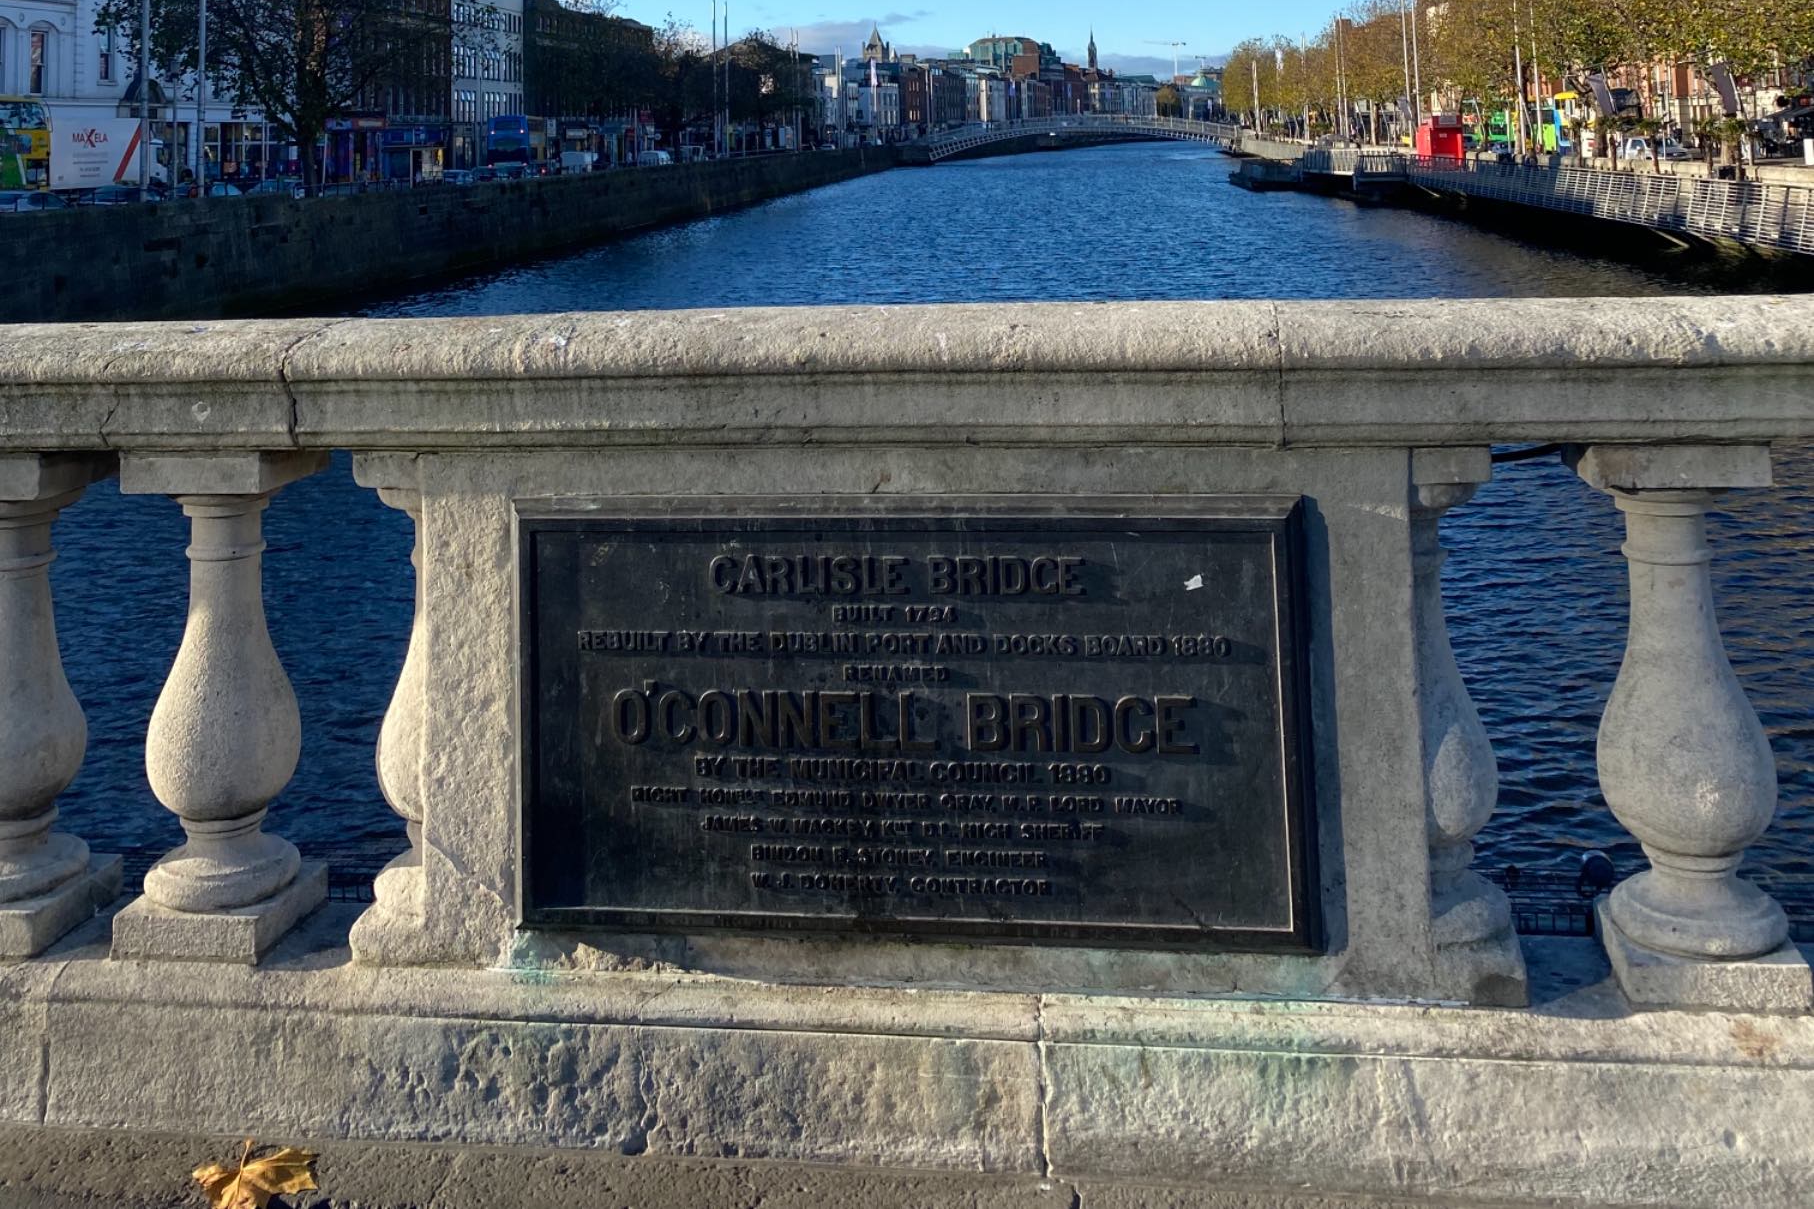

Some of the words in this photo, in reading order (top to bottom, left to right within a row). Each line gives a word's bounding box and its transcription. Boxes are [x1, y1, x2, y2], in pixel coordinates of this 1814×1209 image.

[72, 129, 108, 148] MAXELA
[709, 554, 911, 596] CARLISLE
[927, 555, 1087, 597] BRIDGE
[832, 605, 895, 623] BUILT
[904, 605, 958, 623] 1794
[577, 630, 669, 652] REBUILT
[676, 630, 706, 652] BY
[713, 631, 763, 653] THE
[769, 632, 859, 655] DUBLIN
[865, 633, 933, 655] PORT
[935, 633, 988, 655] AND
[993, 634, 1079, 656] DOCKS
[1084, 635, 1166, 657] BOARD
[1171, 634, 1232, 658] 1880
[843, 664, 949, 682] RENAMED
[612, 679, 939, 752] O'CONNELL
[966, 692, 1201, 756] BRIDGE
[695, 755, 727, 777] BY
[731, 756, 781, 779] THE
[790, 757, 923, 782] MUNICIPAL
[929, 760, 1041, 784] COUNCIL
[1048, 762, 1112, 785] 1880
[631, 785, 688, 803] RIGHT
[770, 789, 852, 808] EDMUND
[861, 791, 932, 810] DWYER
[1049, 796, 1105, 813] LORD
[1114, 797, 1184, 815] MAYOR
[700, 814, 763, 833] JAMES
[960, 822, 1012, 839] HIGH
[1020, 823, 1105, 840] SHERIFF
[751, 844, 824, 862] BINDON
[945, 849, 1048, 867] ENGINEER
[909, 876, 1053, 896] CONTRACTOR
